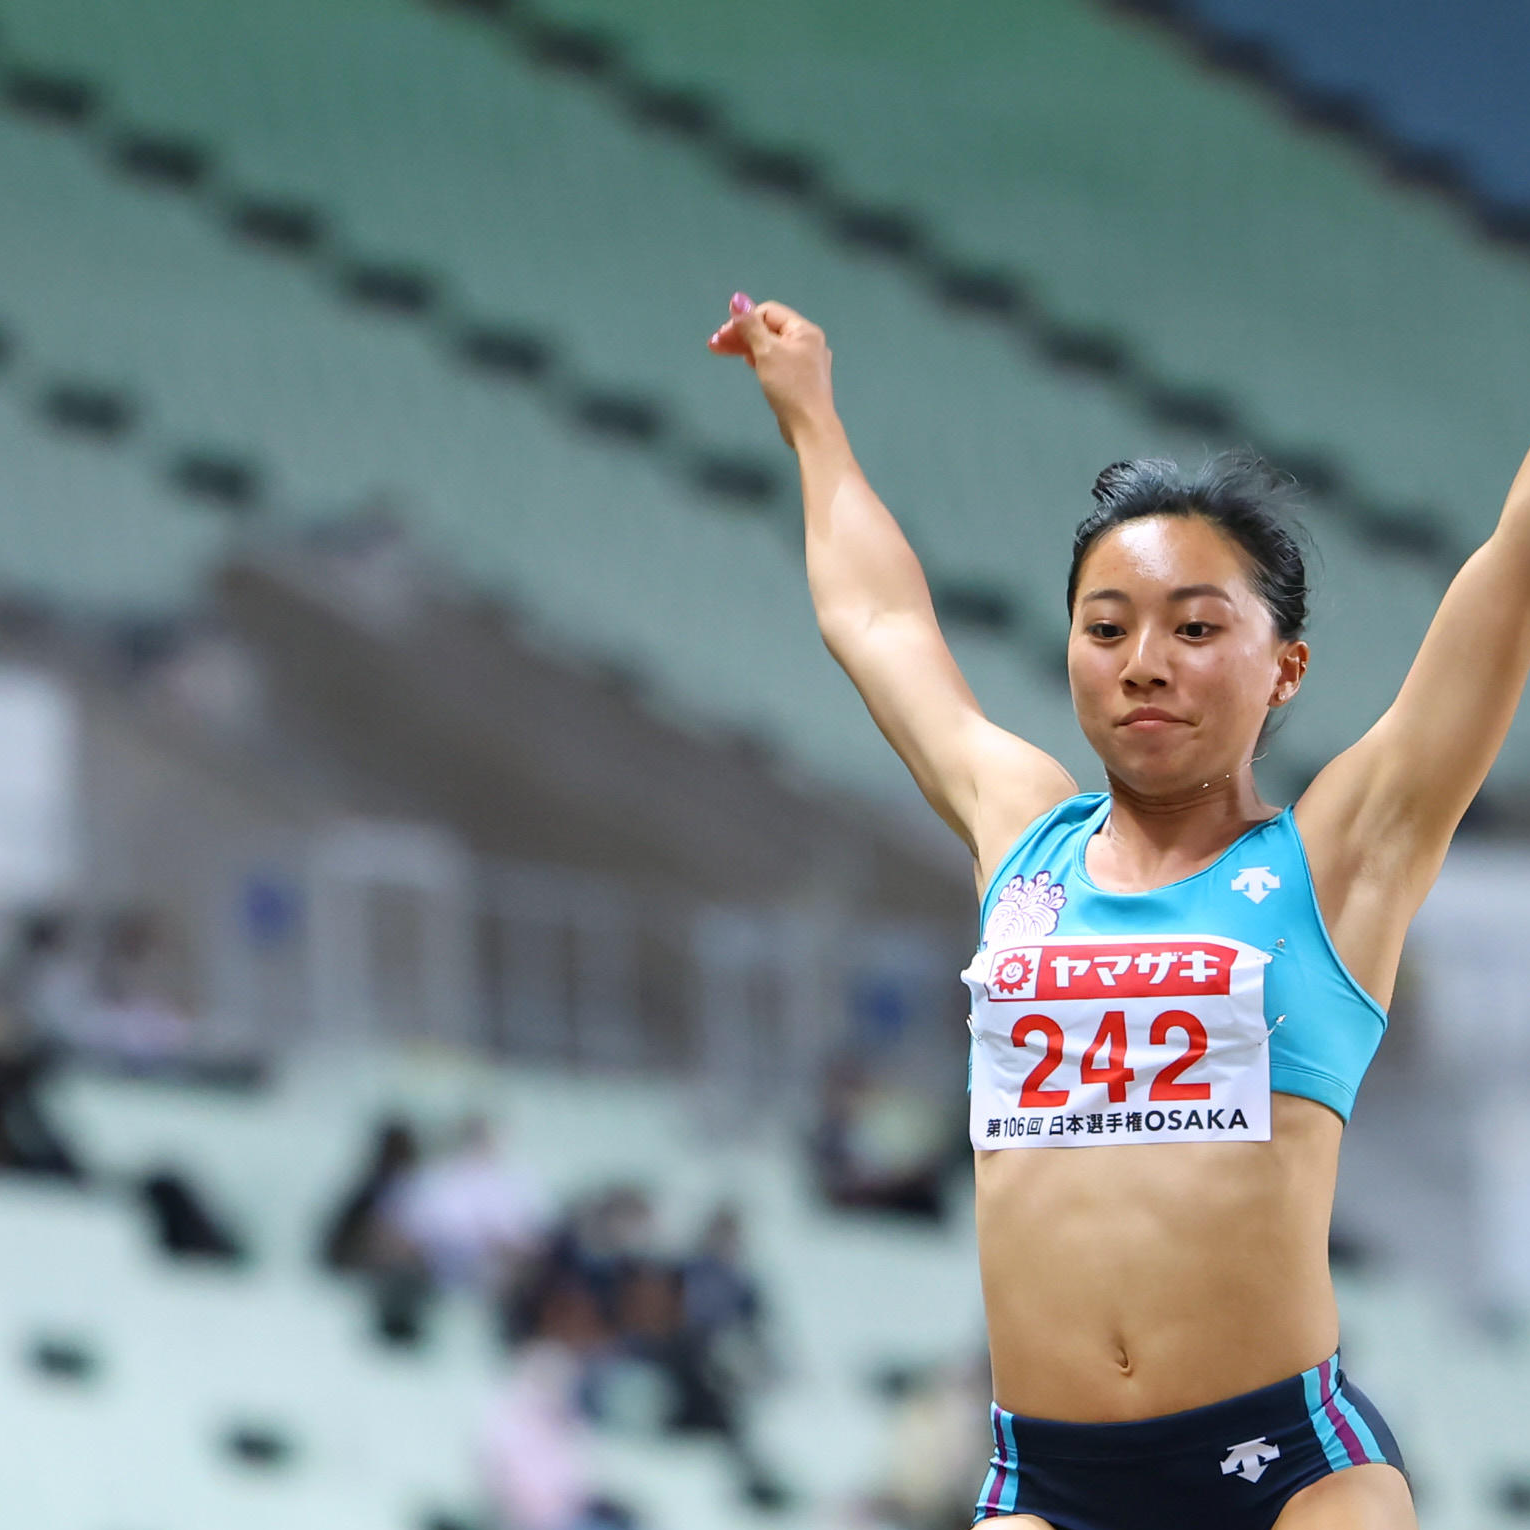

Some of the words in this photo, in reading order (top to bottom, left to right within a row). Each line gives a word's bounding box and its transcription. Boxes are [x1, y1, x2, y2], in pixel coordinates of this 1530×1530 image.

[1050, 950, 1221, 988] ヤマザキ
[1010, 1009, 1212, 1109] 242
[986, 1116, 1044, 1138] 第106回
